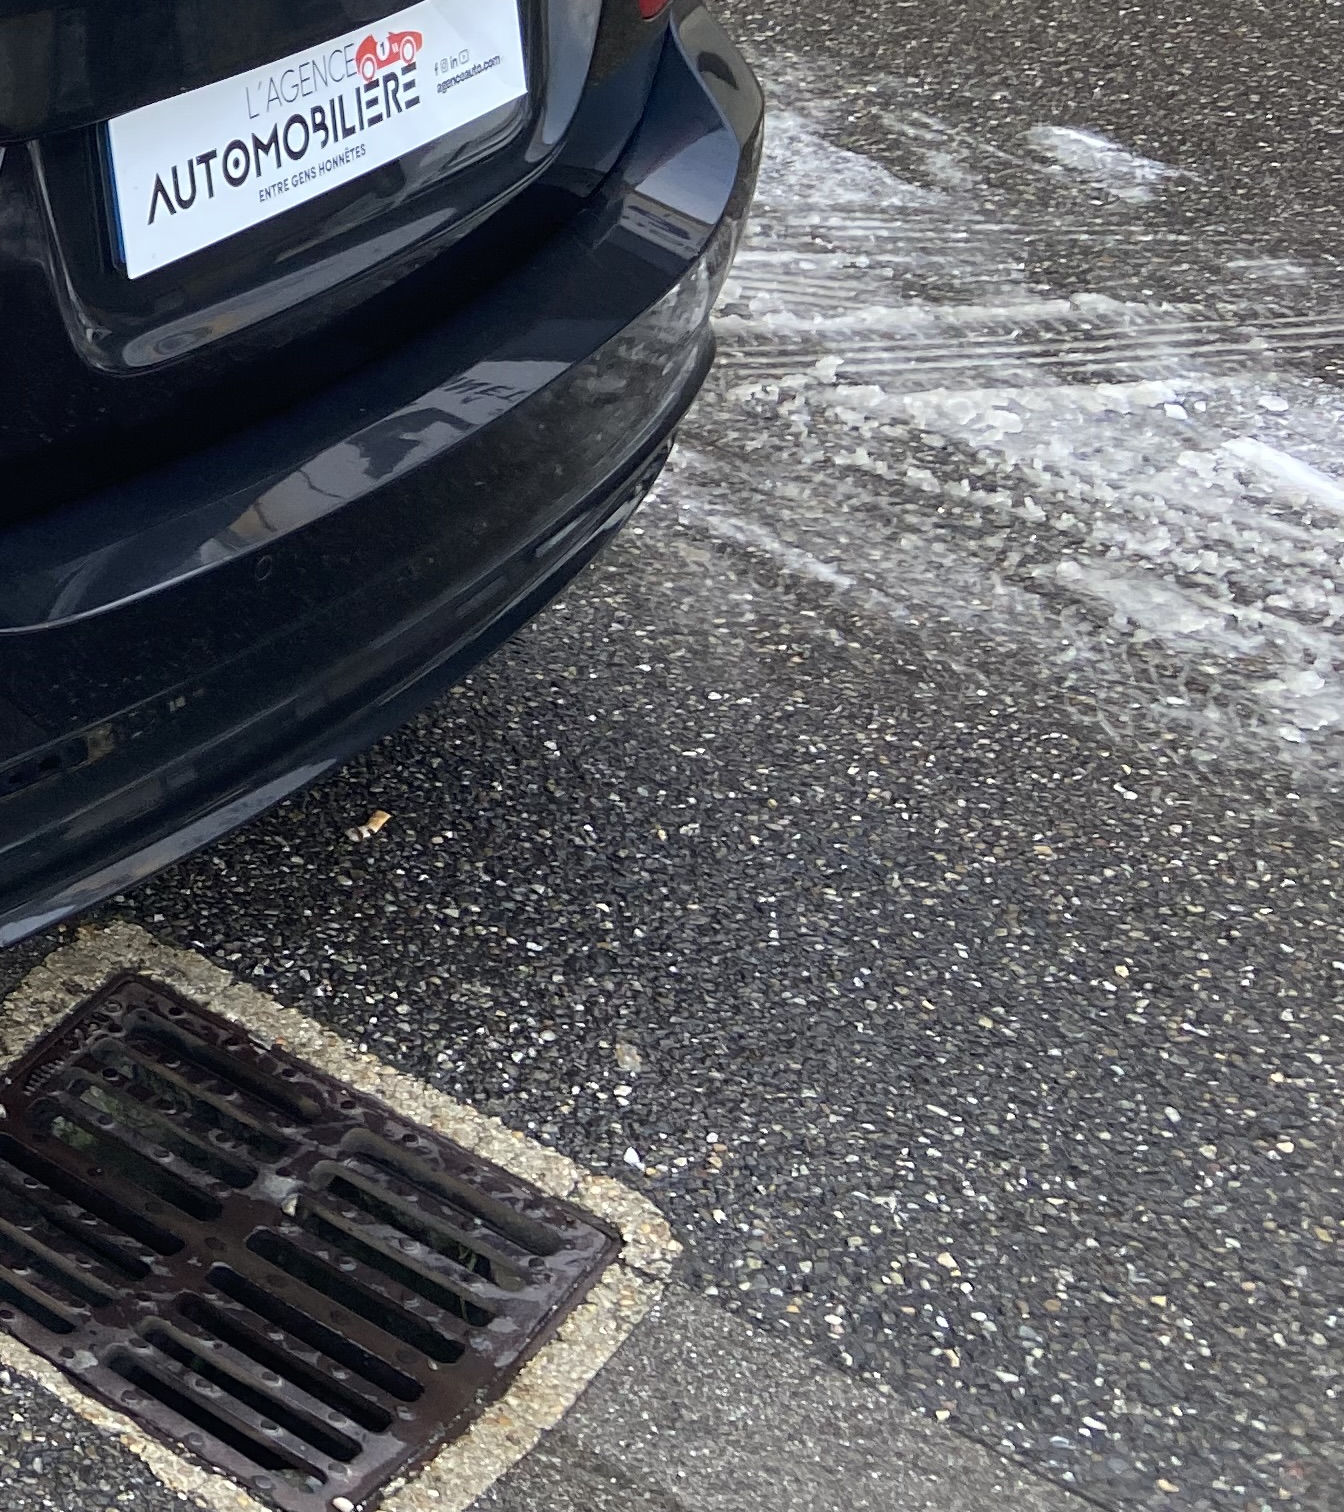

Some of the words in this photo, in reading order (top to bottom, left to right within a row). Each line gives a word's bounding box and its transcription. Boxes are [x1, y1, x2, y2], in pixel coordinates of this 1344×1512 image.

[245, 42, 358, 119] L'AGENCE
[258, 179, 290, 202] ENTRE
[290, 166, 317, 188] GENS
[318, 143, 367, 175] HONNÊTES
